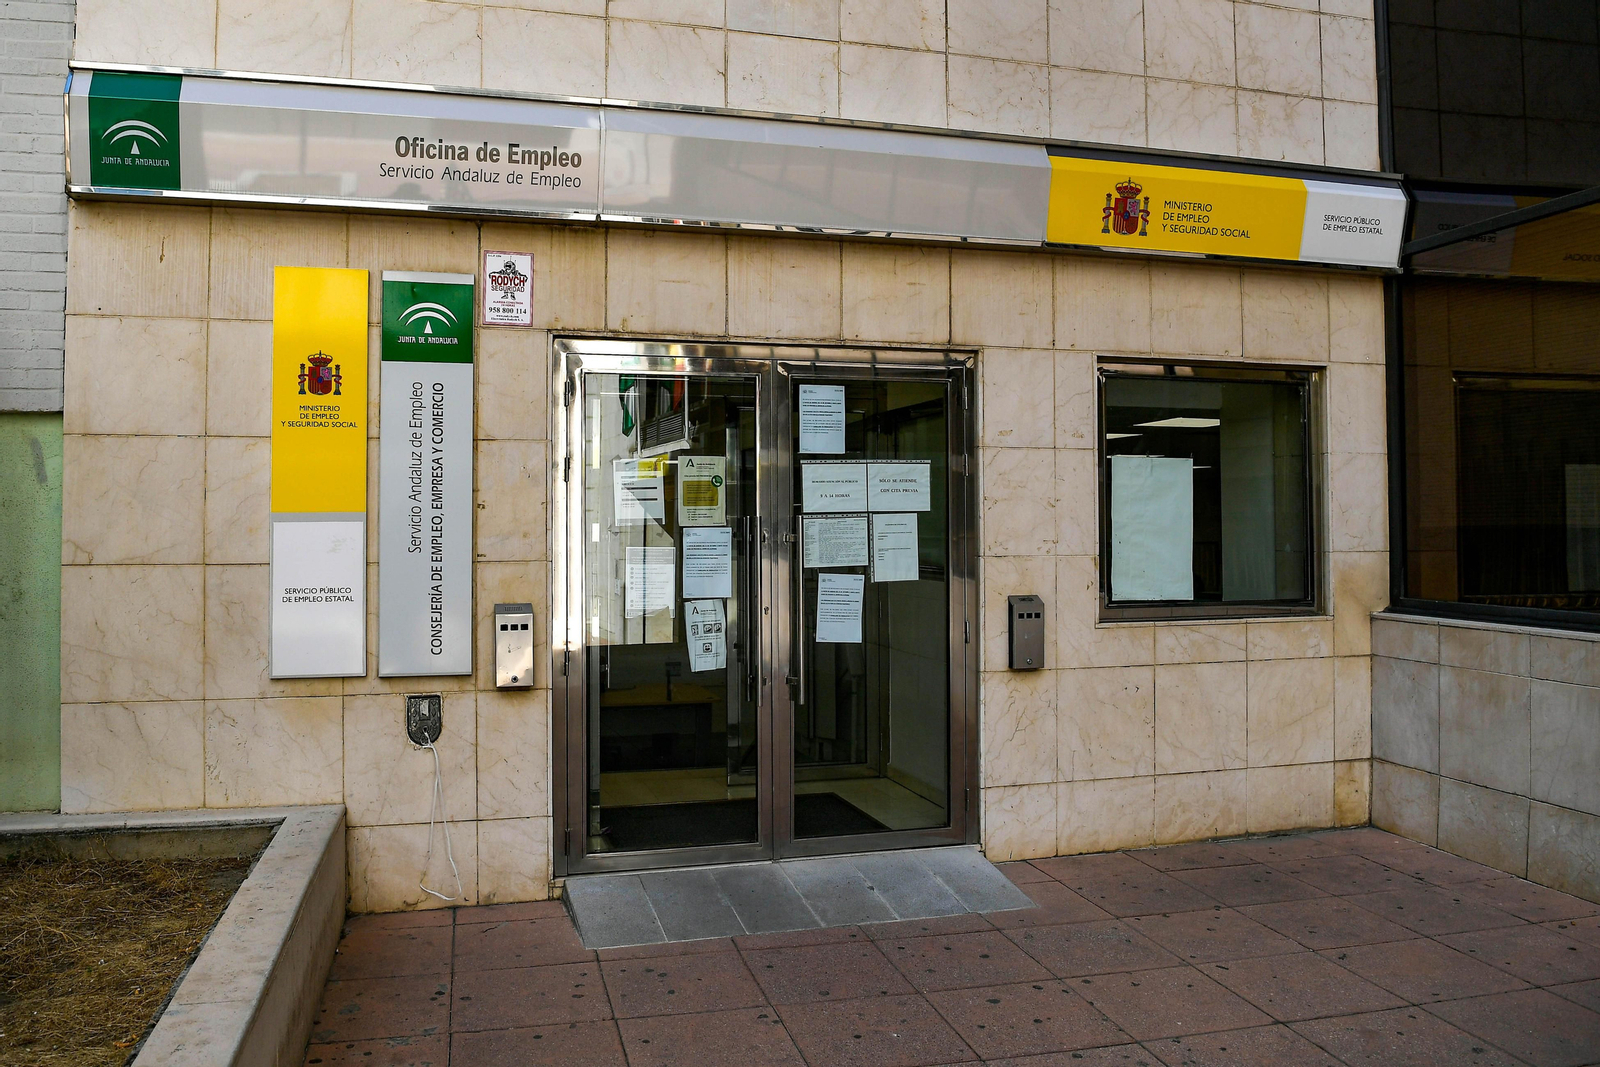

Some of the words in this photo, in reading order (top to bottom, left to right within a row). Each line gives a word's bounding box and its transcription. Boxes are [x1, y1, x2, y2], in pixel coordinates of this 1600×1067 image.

[395, 135, 469, 161] Oficina
[475, 141, 501, 163] de
[508, 143, 582, 170] Empleo
[101, 156, 122, 164] JUNTA
[124, 157, 133, 165] DE
[379, 162, 434, 180] Servicio
[440, 166, 500, 183] Andaluz
[506, 170, 523, 185] de
[530, 171, 581, 190] Empleo
[1163, 200, 1213, 212] MINISTERIO
[1162, 211, 1175, 221] DE
[1176, 213, 1210, 224] EMPLEO
[1323, 214, 1352, 224] SERVICIO
[1353, 215, 1381, 226] PÚBLICO
[1161, 223, 1168, 232] Y
[1169, 224, 1219, 236] SEGURIDAD
[1220, 228, 1251, 239] SOCIAL
[1322, 223, 1332, 231] DE
[1333, 224, 1358, 233] EMPLEO
[1358, 226, 1384, 235] ESTATAL
[490, 275, 525, 287] RODYCH
[490, 285, 525, 293] SEGURIDAD
[397, 335, 416, 344] JUNTA
[418, 336, 426, 344] DE
[408, 381, 427, 428] Empleo
[431, 382, 444, 444] COMERCIO
[287, 420, 330, 428] SEGURIDAD
[408, 432, 423, 448] de
[431, 446, 443, 455] Y
[408, 451, 423, 503] Andaluz
[431, 457, 443, 510] EMPRESA
[407, 506, 422, 553] Servicio
[430, 513, 445, 562] EMPLEO,
[430, 565, 443, 581] DE
[284, 587, 318, 595] SERVICIO
[319, 586, 352, 594] PÚBLICO
[294, 595, 323, 603] EMPLEO
[427, 584, 443, 656] CONSEJERÍA
